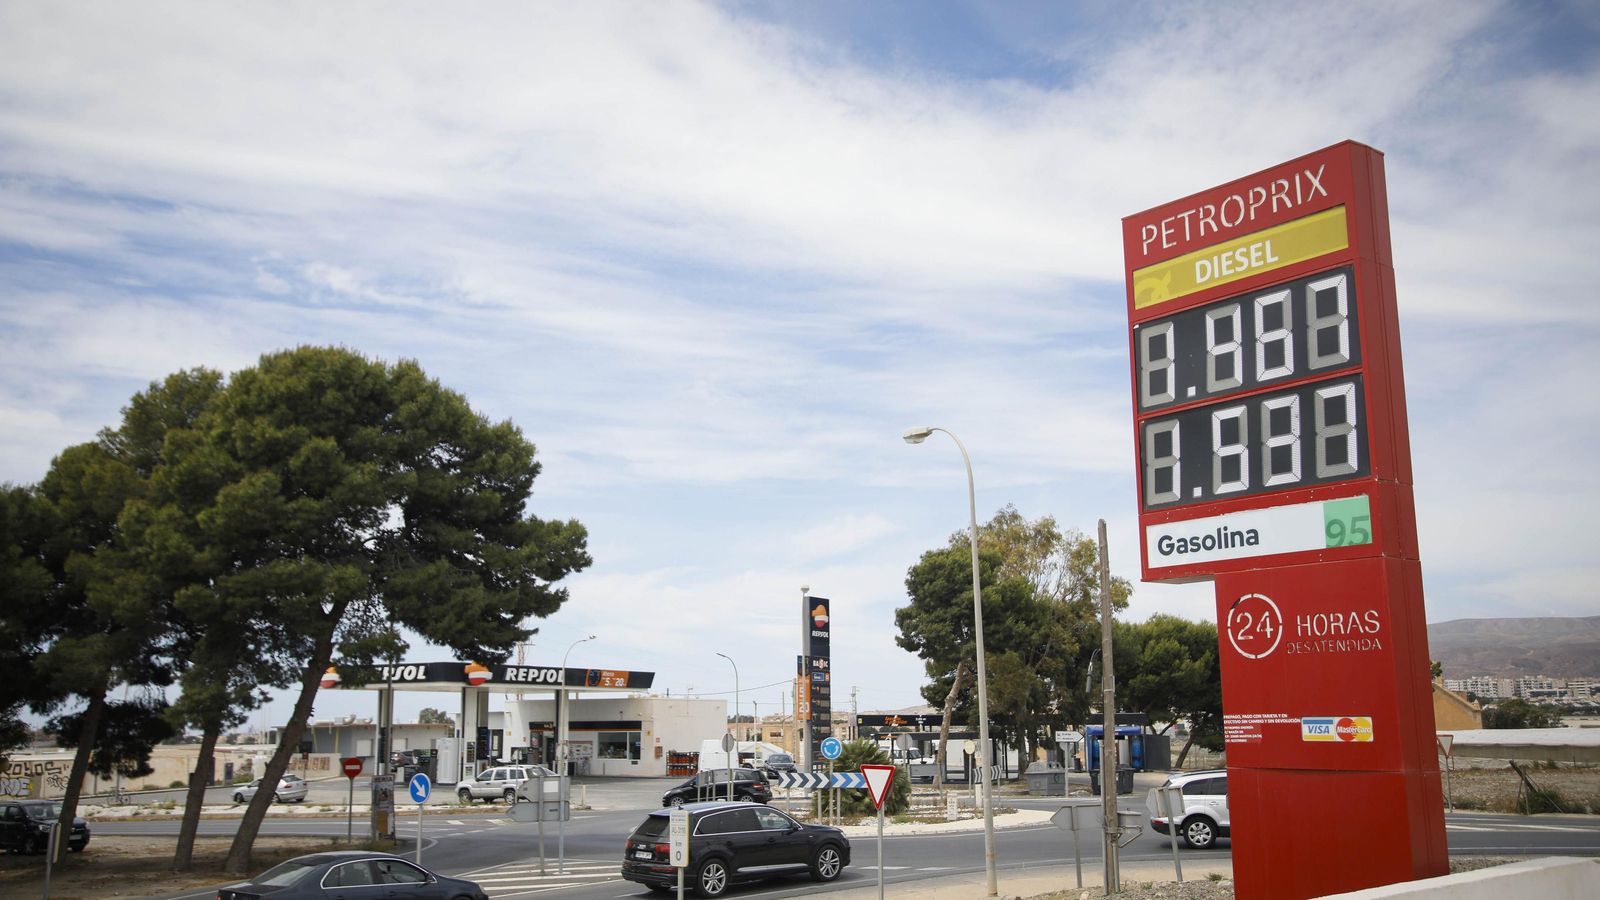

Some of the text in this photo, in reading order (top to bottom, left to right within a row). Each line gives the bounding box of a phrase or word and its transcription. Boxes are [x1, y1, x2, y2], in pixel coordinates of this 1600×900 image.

[1141, 163, 1328, 255] PETROPRIX
[1195, 239, 1279, 284] DIESEL
[1142, 273, 1350, 407] 1.467
[1146, 382, 1358, 505] 1.537
[1157, 514, 1371, 556] Gasolina 95
[1236, 609, 1381, 641] 24 HORAS
[1287, 638, 1382, 654] DESATENDIDA
[379, 665, 426, 681] PSOL
[1308, 725, 1372, 735] VISA MasterCard
